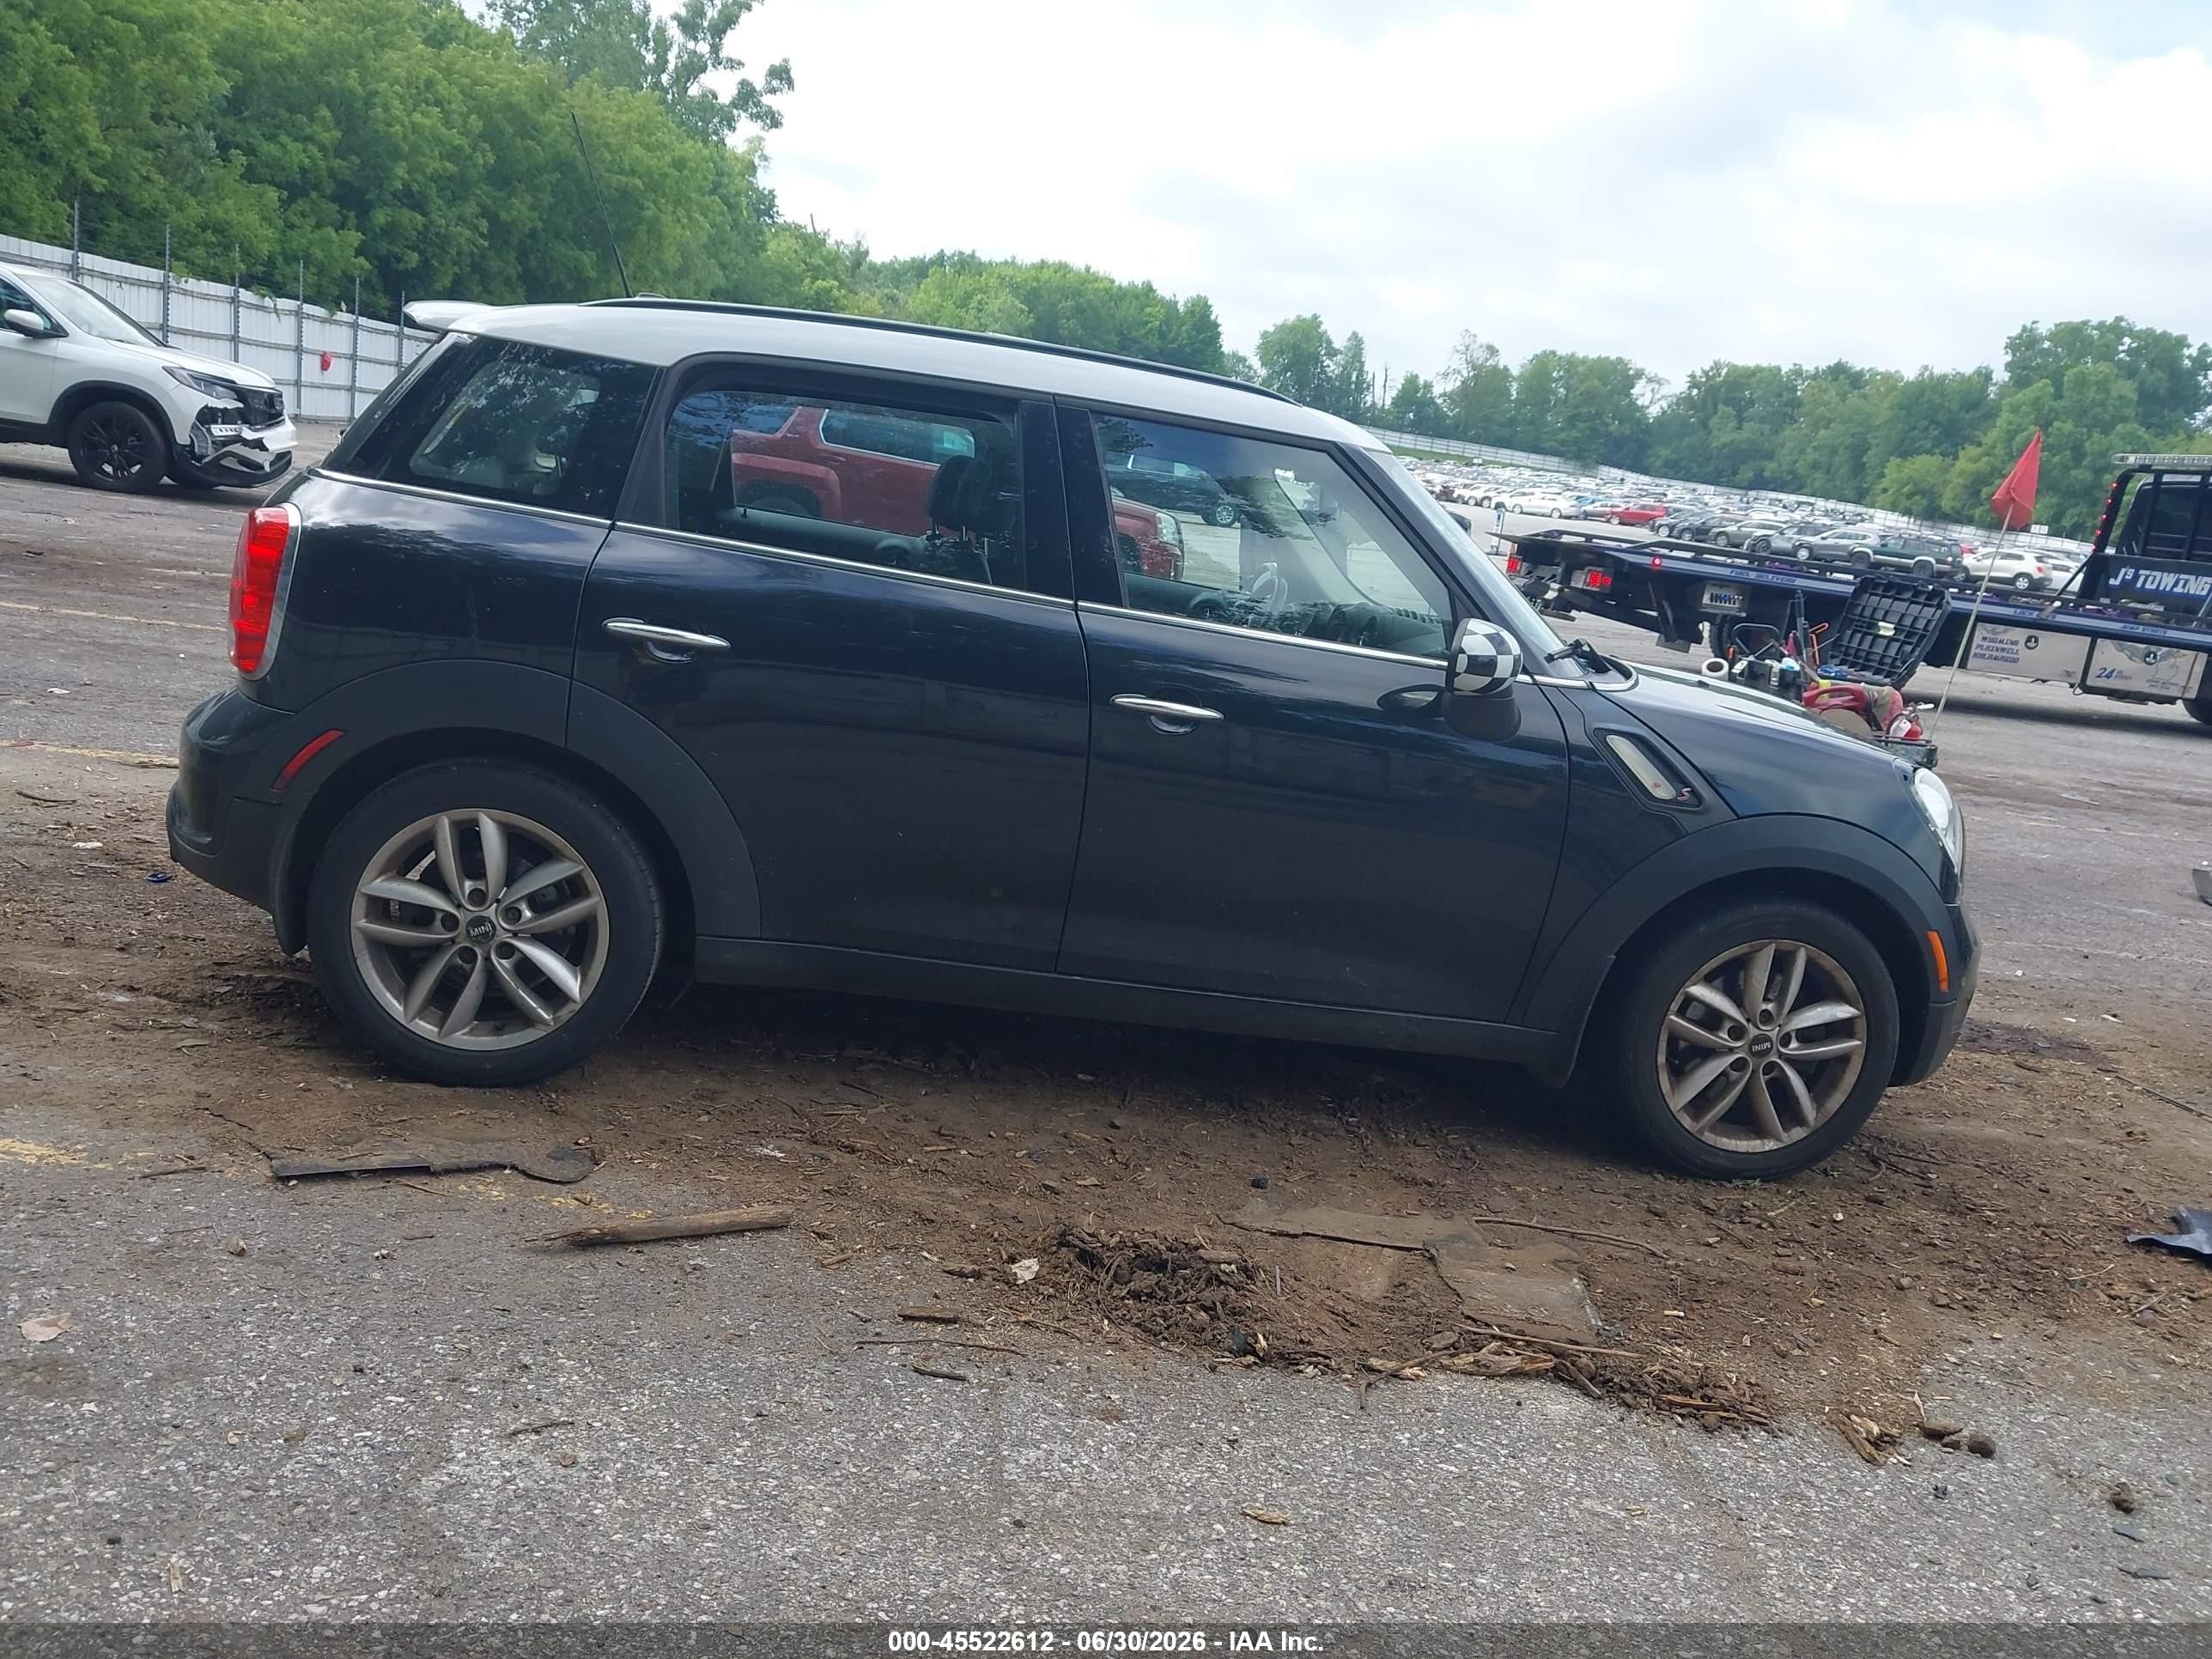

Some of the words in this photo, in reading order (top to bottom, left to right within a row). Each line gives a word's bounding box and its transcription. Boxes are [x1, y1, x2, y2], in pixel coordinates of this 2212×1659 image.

[2109, 566, 2135, 585] J's
[2136, 569, 2212, 595] TOWING
[2095, 666, 2116, 679] 24
[469, 921, 493, 937] MINI
[1752, 1041, 1771, 1053] MINI
